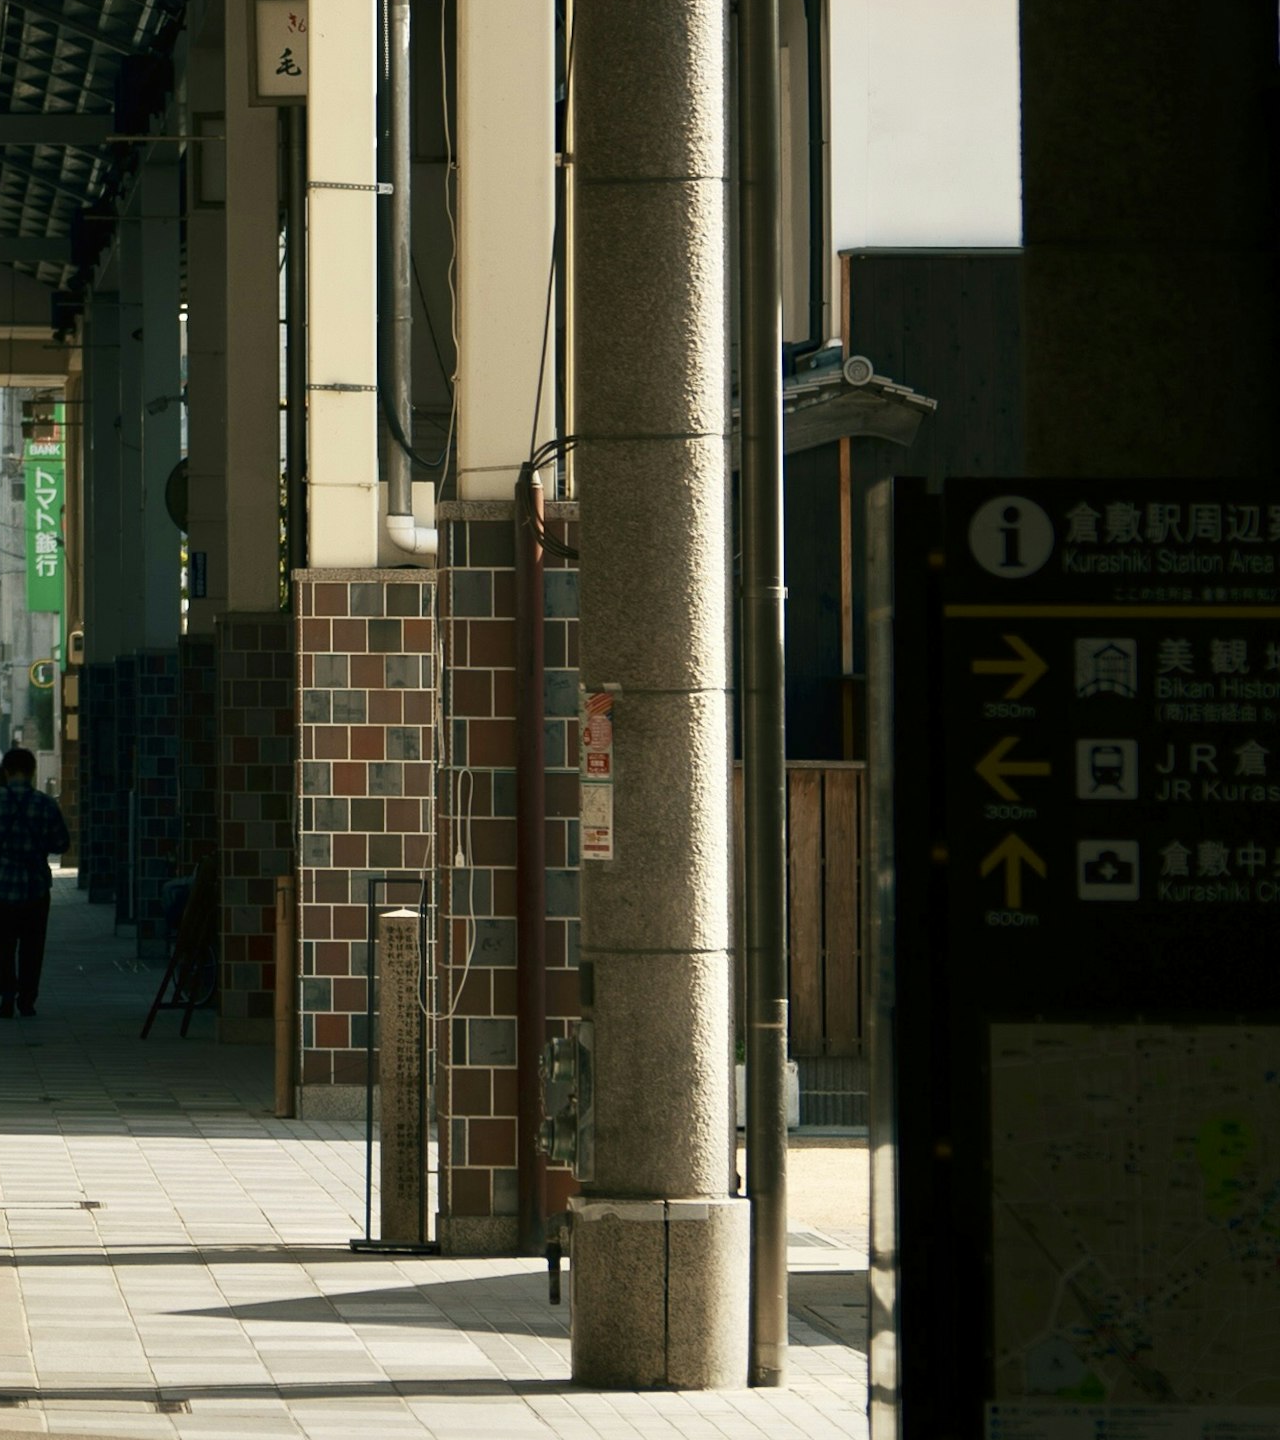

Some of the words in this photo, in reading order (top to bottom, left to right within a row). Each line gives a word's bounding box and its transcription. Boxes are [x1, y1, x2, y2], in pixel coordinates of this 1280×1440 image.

[276, 47, 302, 76] 毛
[29, 442, 61, 456] BANK
[35, 466, 58, 577] トマト銀行
[1062, 547, 1151, 574] Kurashiki
[1156, 547, 1223, 574] Station
[1229, 547, 1275, 574] Area
[1156, 675, 1215, 700] Bikan
[982, 702, 1037, 719] 350m
[1154, 780, 1191, 802] JR
[983, 804, 1038, 820] 300m
[1157, 882, 1249, 903] Kurashiki
[984, 911, 1040, 927] 600m
